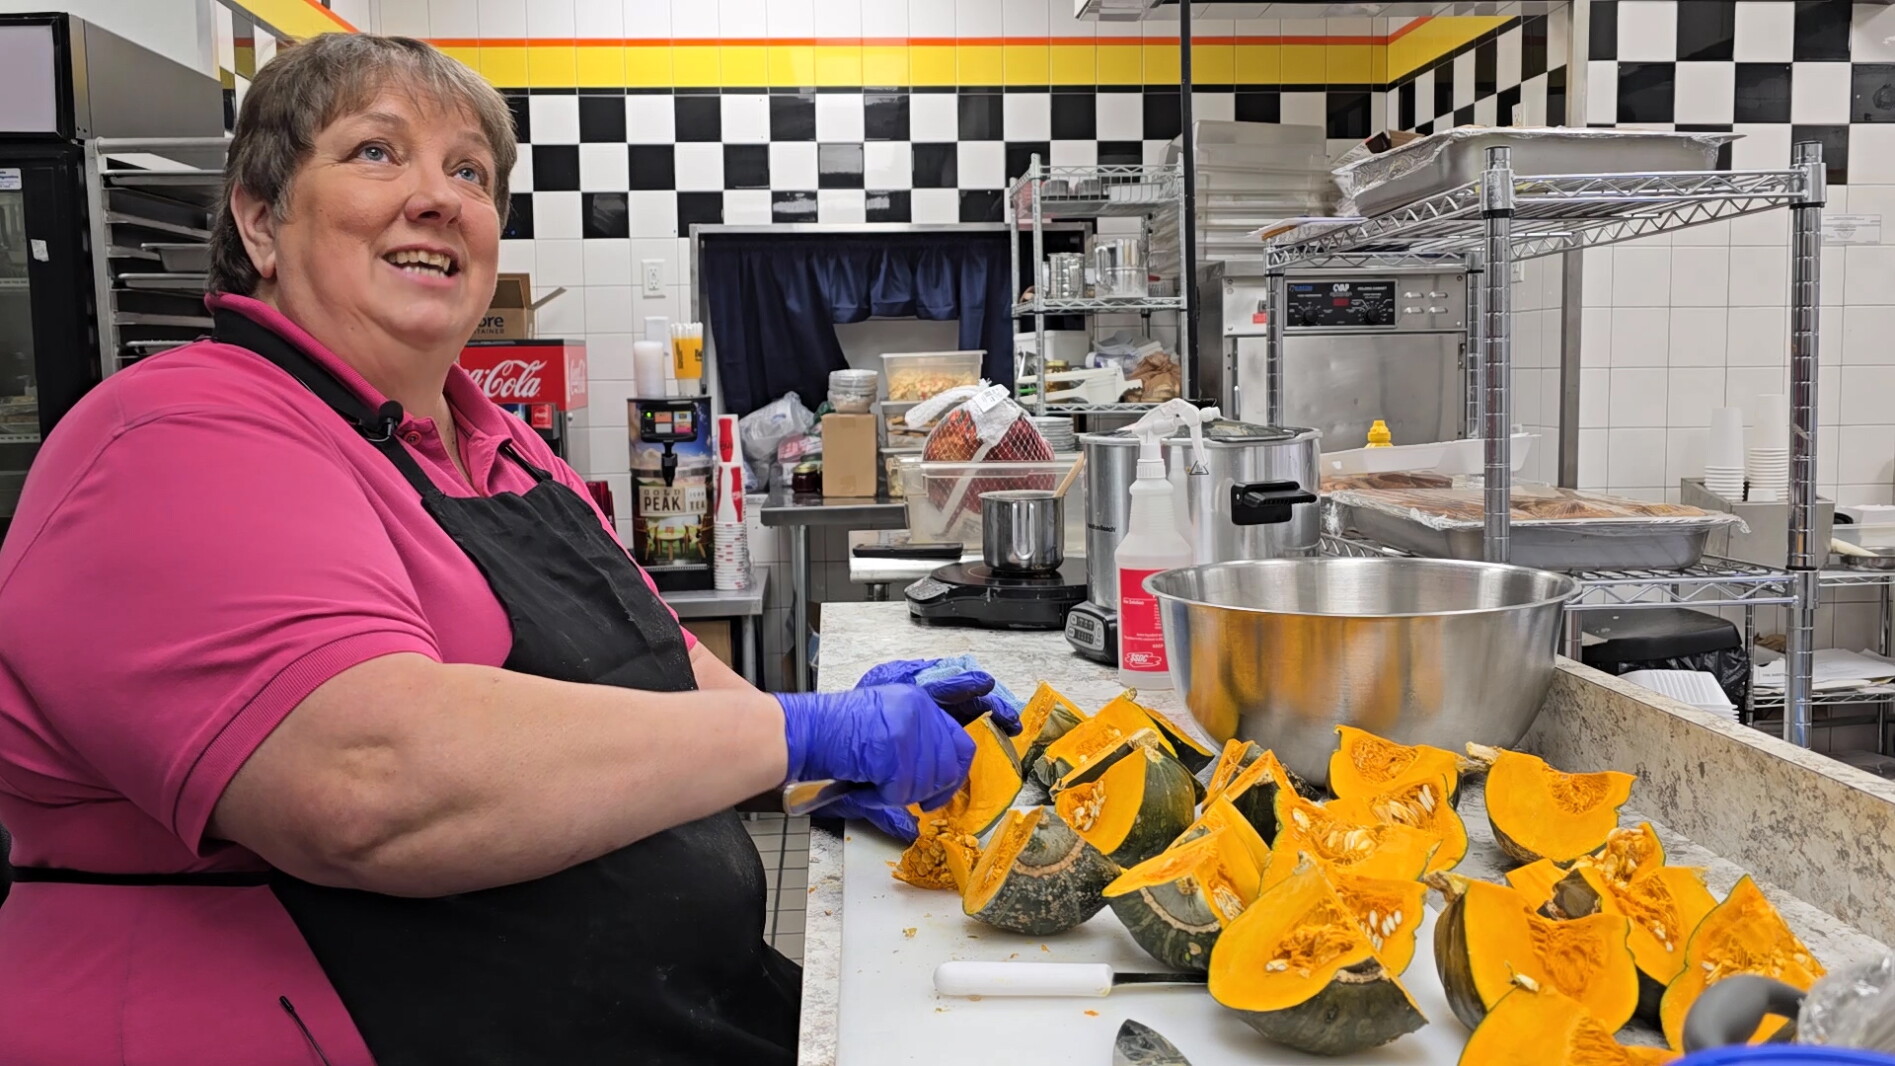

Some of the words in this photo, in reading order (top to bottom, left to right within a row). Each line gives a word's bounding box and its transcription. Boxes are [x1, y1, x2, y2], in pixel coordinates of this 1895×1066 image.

[478, 316, 504, 328] ore
[644, 496, 681, 511] PEAK
[690, 500, 705, 511] TEA
